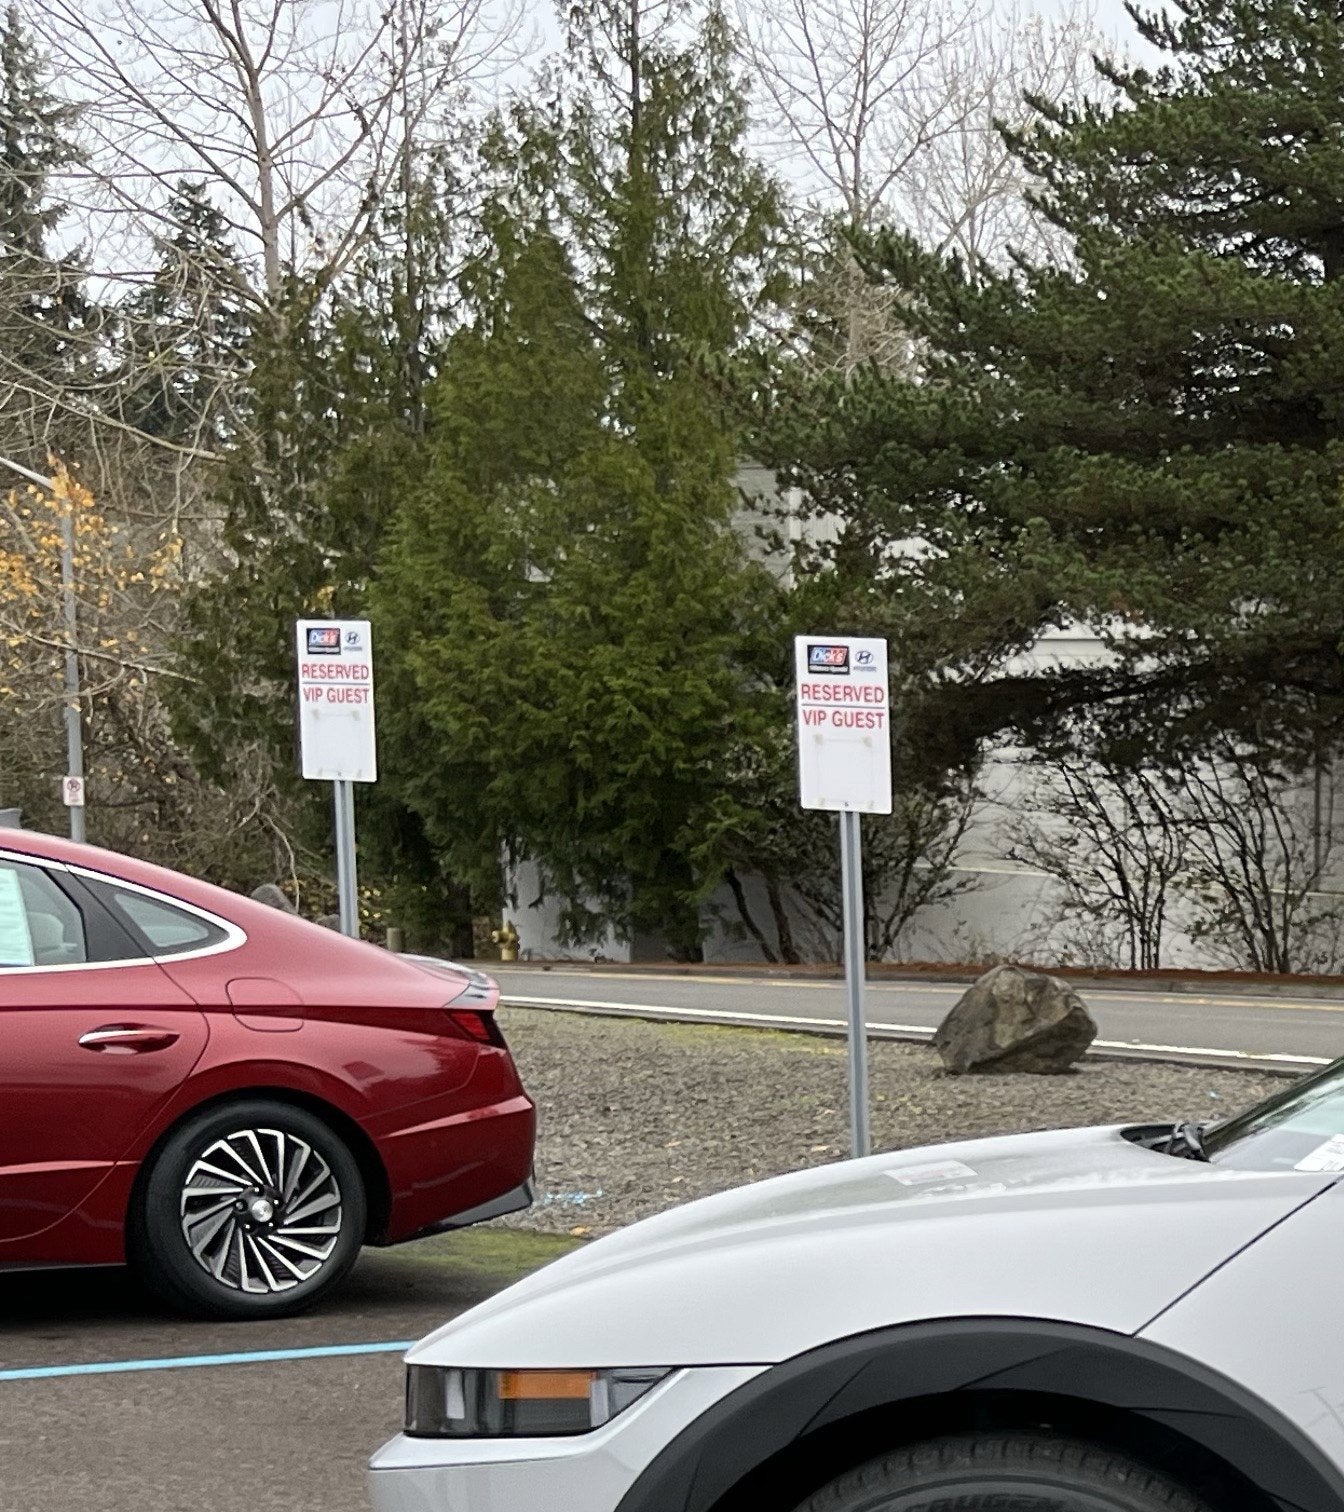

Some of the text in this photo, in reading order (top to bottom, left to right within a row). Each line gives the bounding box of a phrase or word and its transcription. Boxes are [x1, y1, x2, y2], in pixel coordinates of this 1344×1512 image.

[301, 663, 370, 680] RESERVED
[303, 687, 370, 704] VIP GUEST
[801, 683, 884, 703] RESERVED
[802, 709, 884, 729] VIP GUEST
